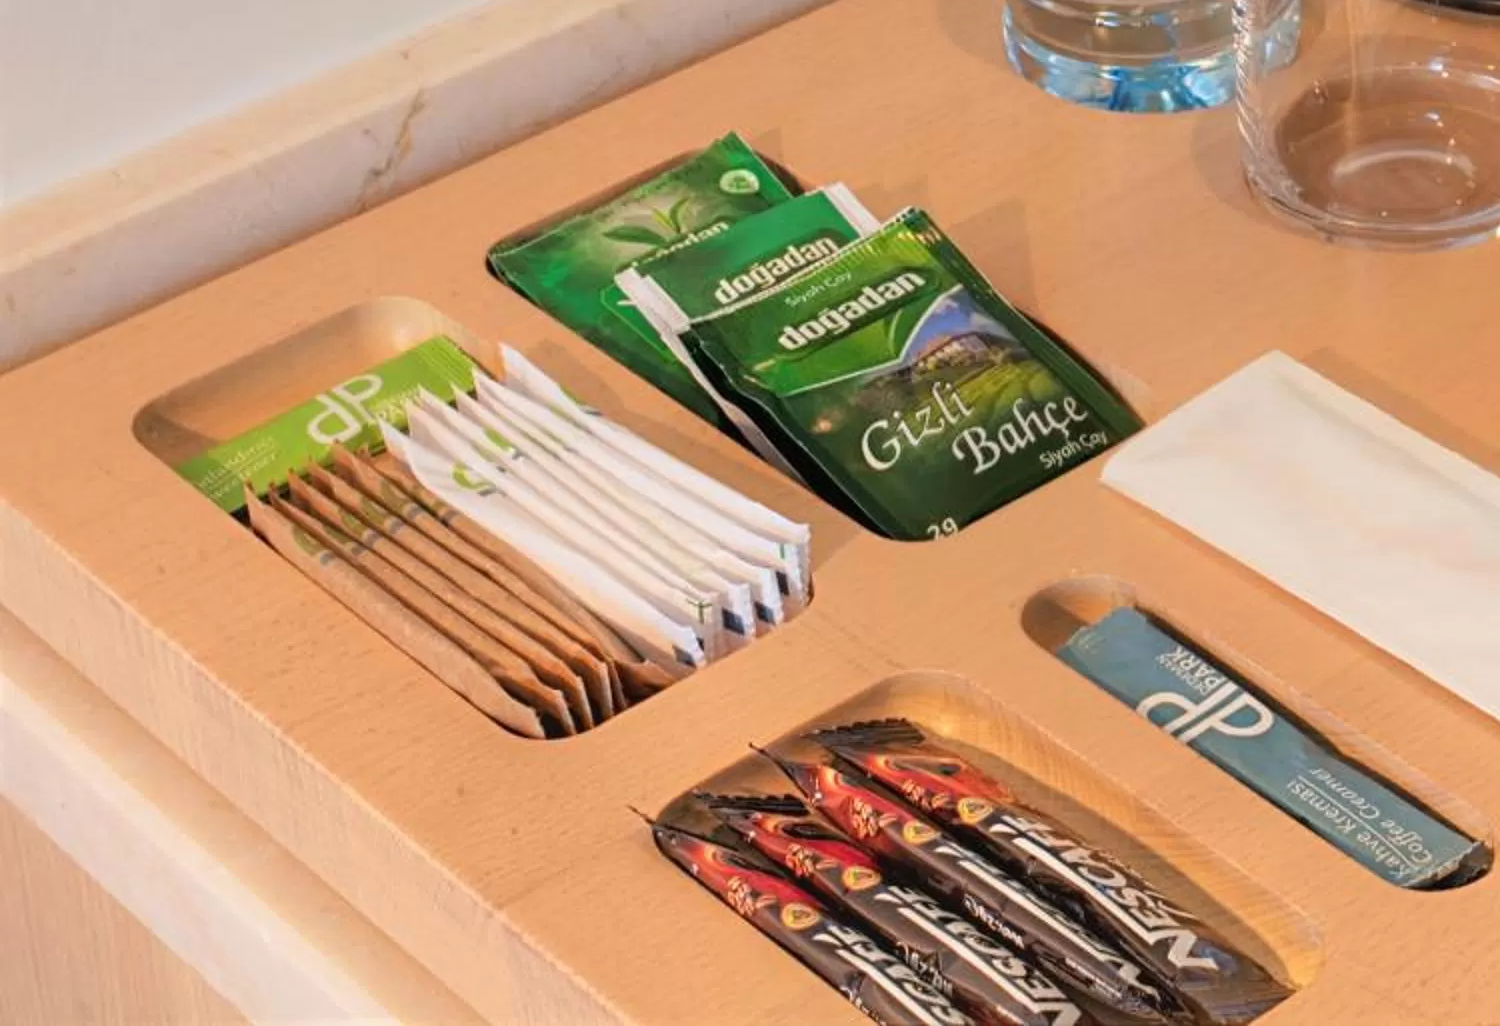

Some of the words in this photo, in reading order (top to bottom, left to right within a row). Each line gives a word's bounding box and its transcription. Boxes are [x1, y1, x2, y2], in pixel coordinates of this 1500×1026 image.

[778, 272, 926, 350] doğadan
[861, 381, 976, 472] Gizli
[952, 396, 1088, 474] Bahçe
[1175, 645, 1227, 688] PARK
[1309, 768, 1380, 820] Creamer
[1380, 819, 1433, 864] Coffee
